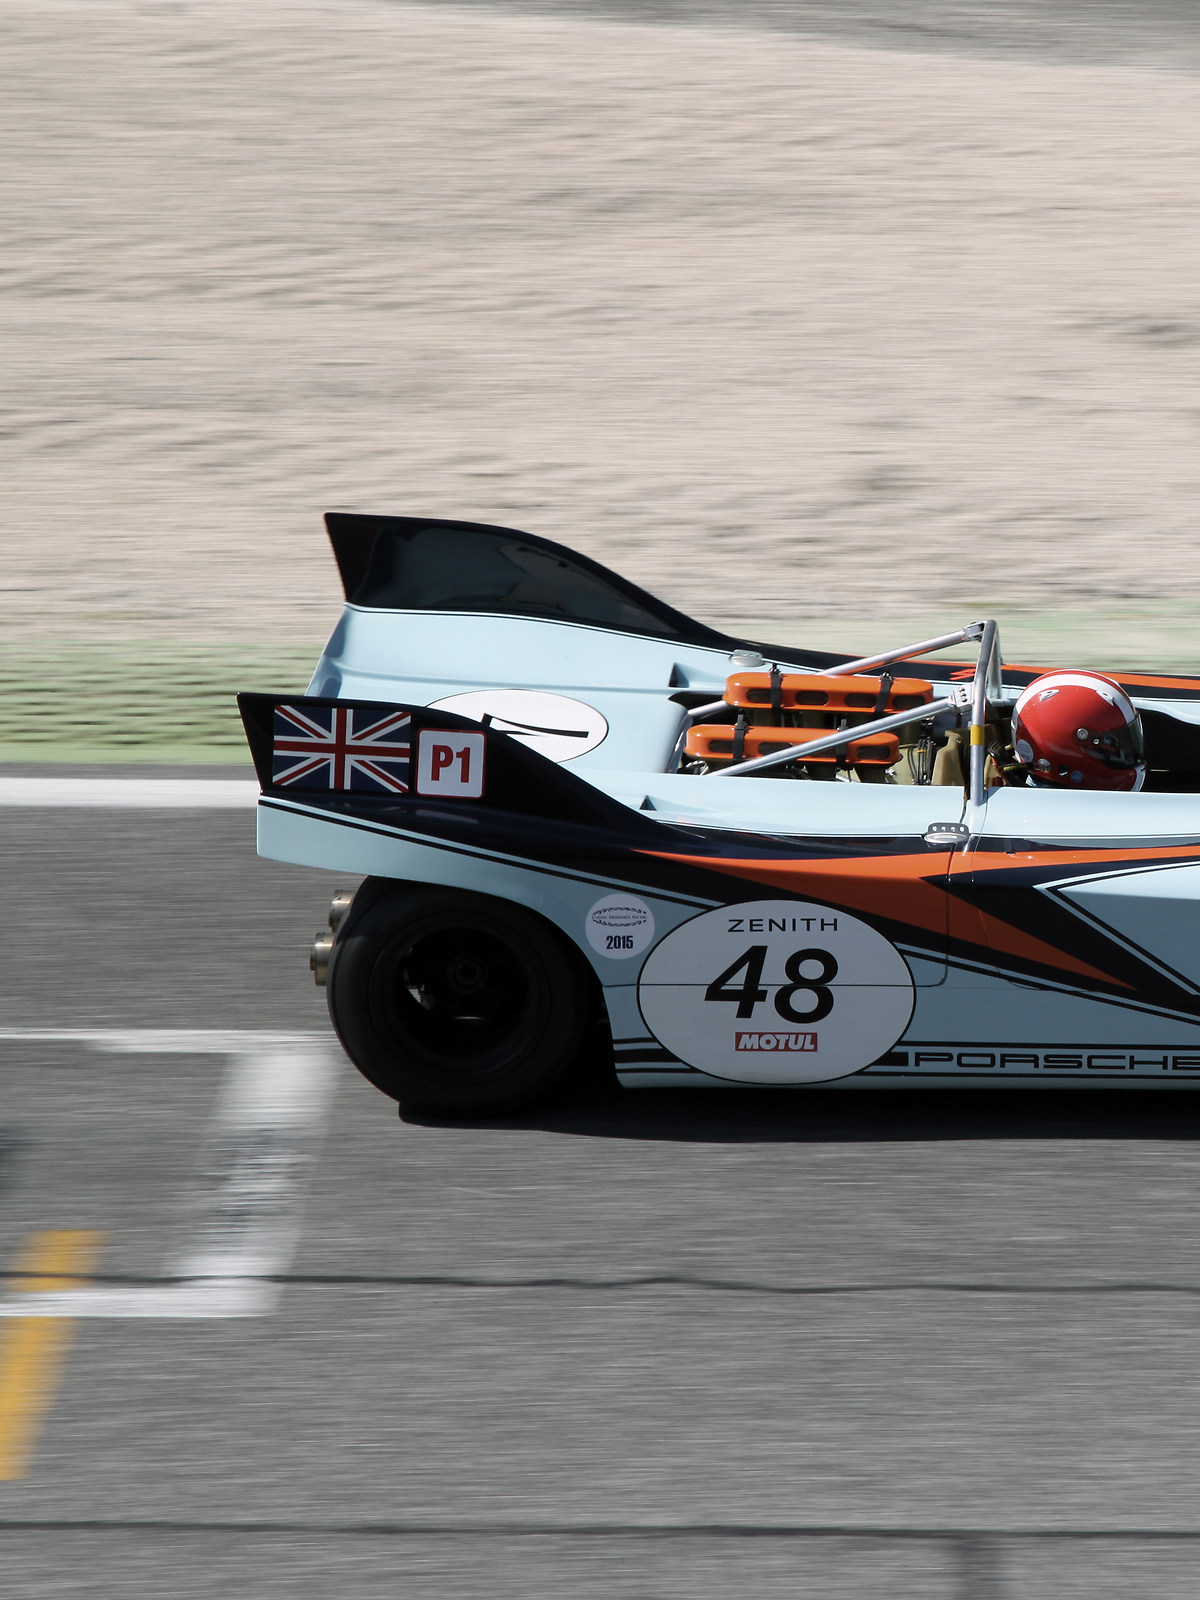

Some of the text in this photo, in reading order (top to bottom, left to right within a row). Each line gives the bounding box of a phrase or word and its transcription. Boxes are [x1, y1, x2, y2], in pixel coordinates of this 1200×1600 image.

[431, 745, 471, 783] P1
[728, 918, 838, 932] ZENITH
[606, 935, 633, 949] 2015
[704, 945, 838, 1024] 48
[737, 1033, 815, 1051] MOTUL
